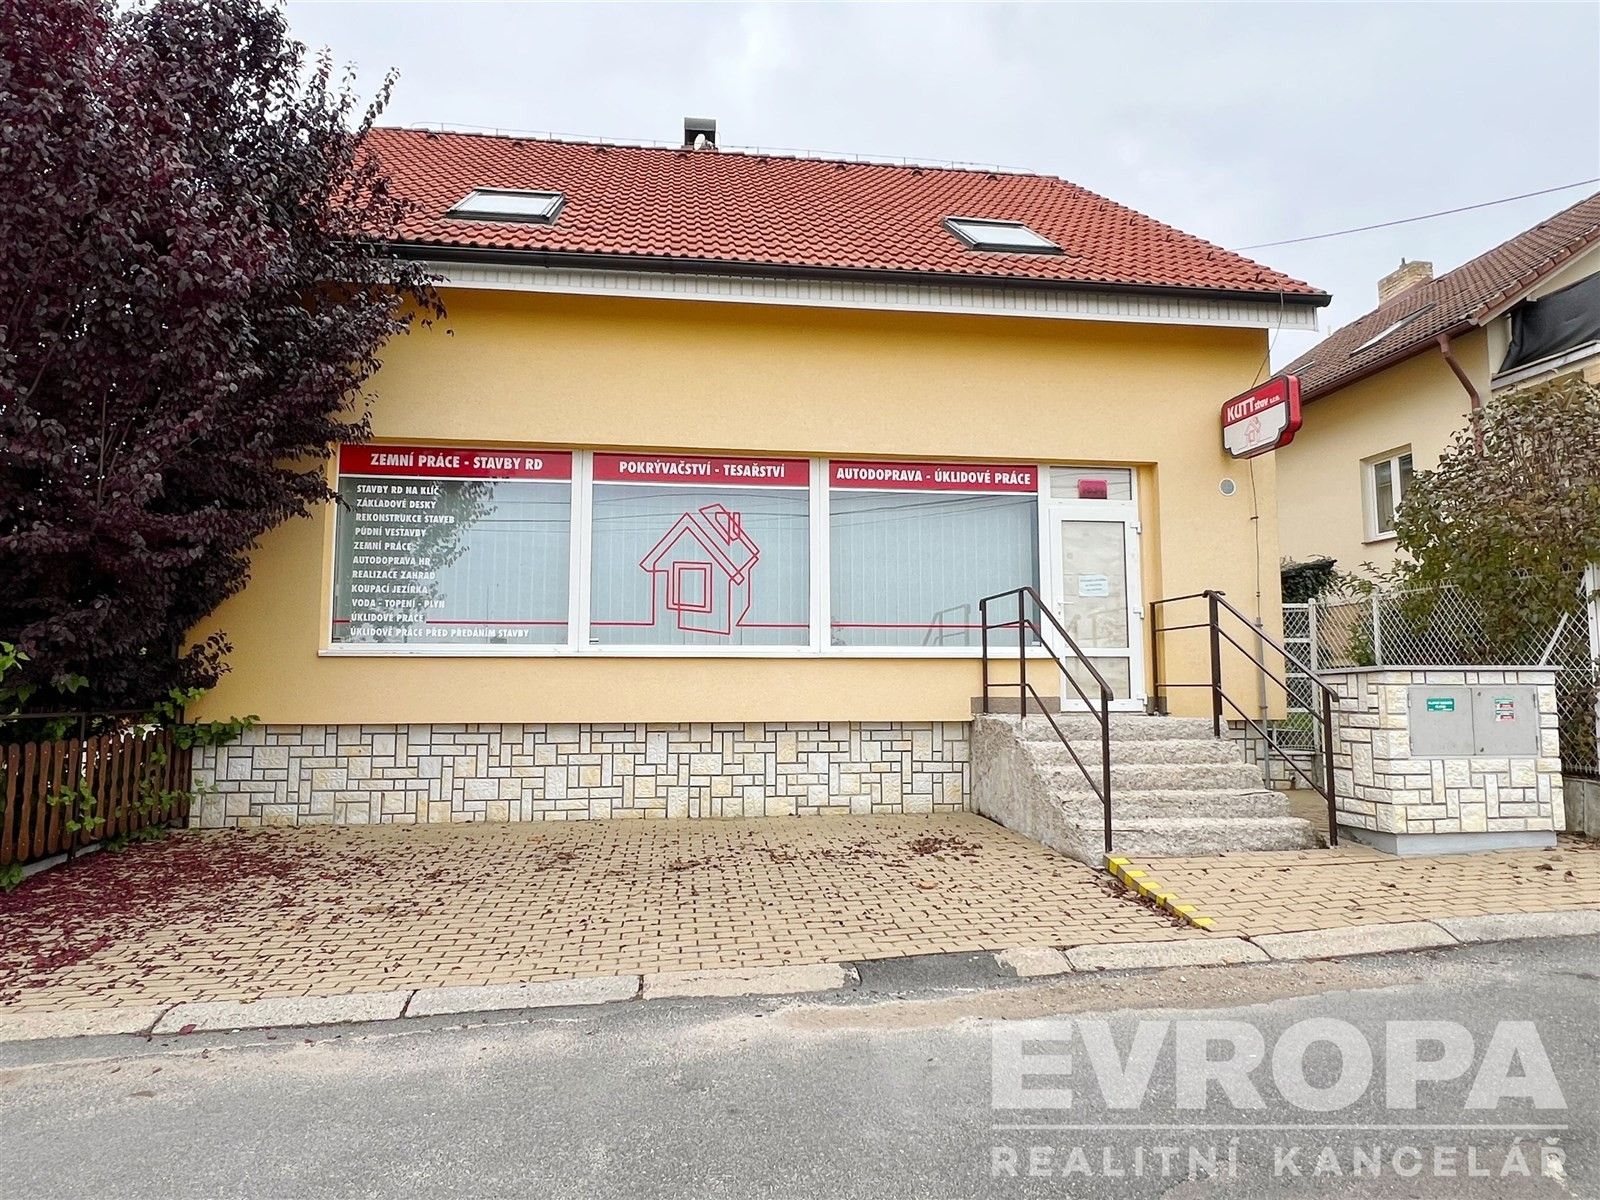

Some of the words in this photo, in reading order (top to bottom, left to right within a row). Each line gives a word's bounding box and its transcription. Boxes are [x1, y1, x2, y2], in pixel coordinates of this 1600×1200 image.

[1227, 397, 1255, 422] KUTT
[371, 452, 414, 466] ZEMNÍ
[418, 453, 460, 468] PRÁCE
[473, 457, 521, 470] STAVBY
[525, 458, 543, 471] RD
[619, 459, 711, 476] POKRÝVAČSTVÍ
[723, 462, 785, 478] TESAŘSTVÍ
[836, 467, 923, 482] AUTODOPRAVA
[934, 468, 991, 484] ÚKLIDOVÉ
[995, 470, 1031, 484] PRÁCE
[356, 484, 388, 494] STAVBY
[391, 486, 403, 494] RD
[406, 486, 418, 494] NA
[420, 485, 440, 495] KLÍČ
[356, 497, 406, 508] ZÁKLADOVÉ
[410, 501, 437, 509] DESKY
[356, 513, 422, 522] REKONSTRUKCE
[424, 516, 455, 524] STAVEB
[385, 528, 427, 537] VESTAVBY
[354, 540, 382, 550] ZEMNÍ
[384, 541, 411, 550] PRÁCE
[352, 556, 416, 565] AUTODOPRAVA
[352, 570, 398, 579] REALIZACE
[400, 571, 436, 580] ZAHRAD
[352, 583, 390, 593] KOUPACÍ
[392, 584, 428, 594] JEZÍRKA
[352, 598, 376, 607] VODA
[385, 598, 416, 608] TOPENÍ
[424, 600, 445, 608] PLYN
[350, 612, 394, 622] ÚKLIDOVÉ
[350, 626, 393, 636] ÚKLIDOVÉ
[395, 626, 424, 637] PRÁCE
[426, 626, 448, 637] PŘED
[498, 628, 529, 638] STAVBY
